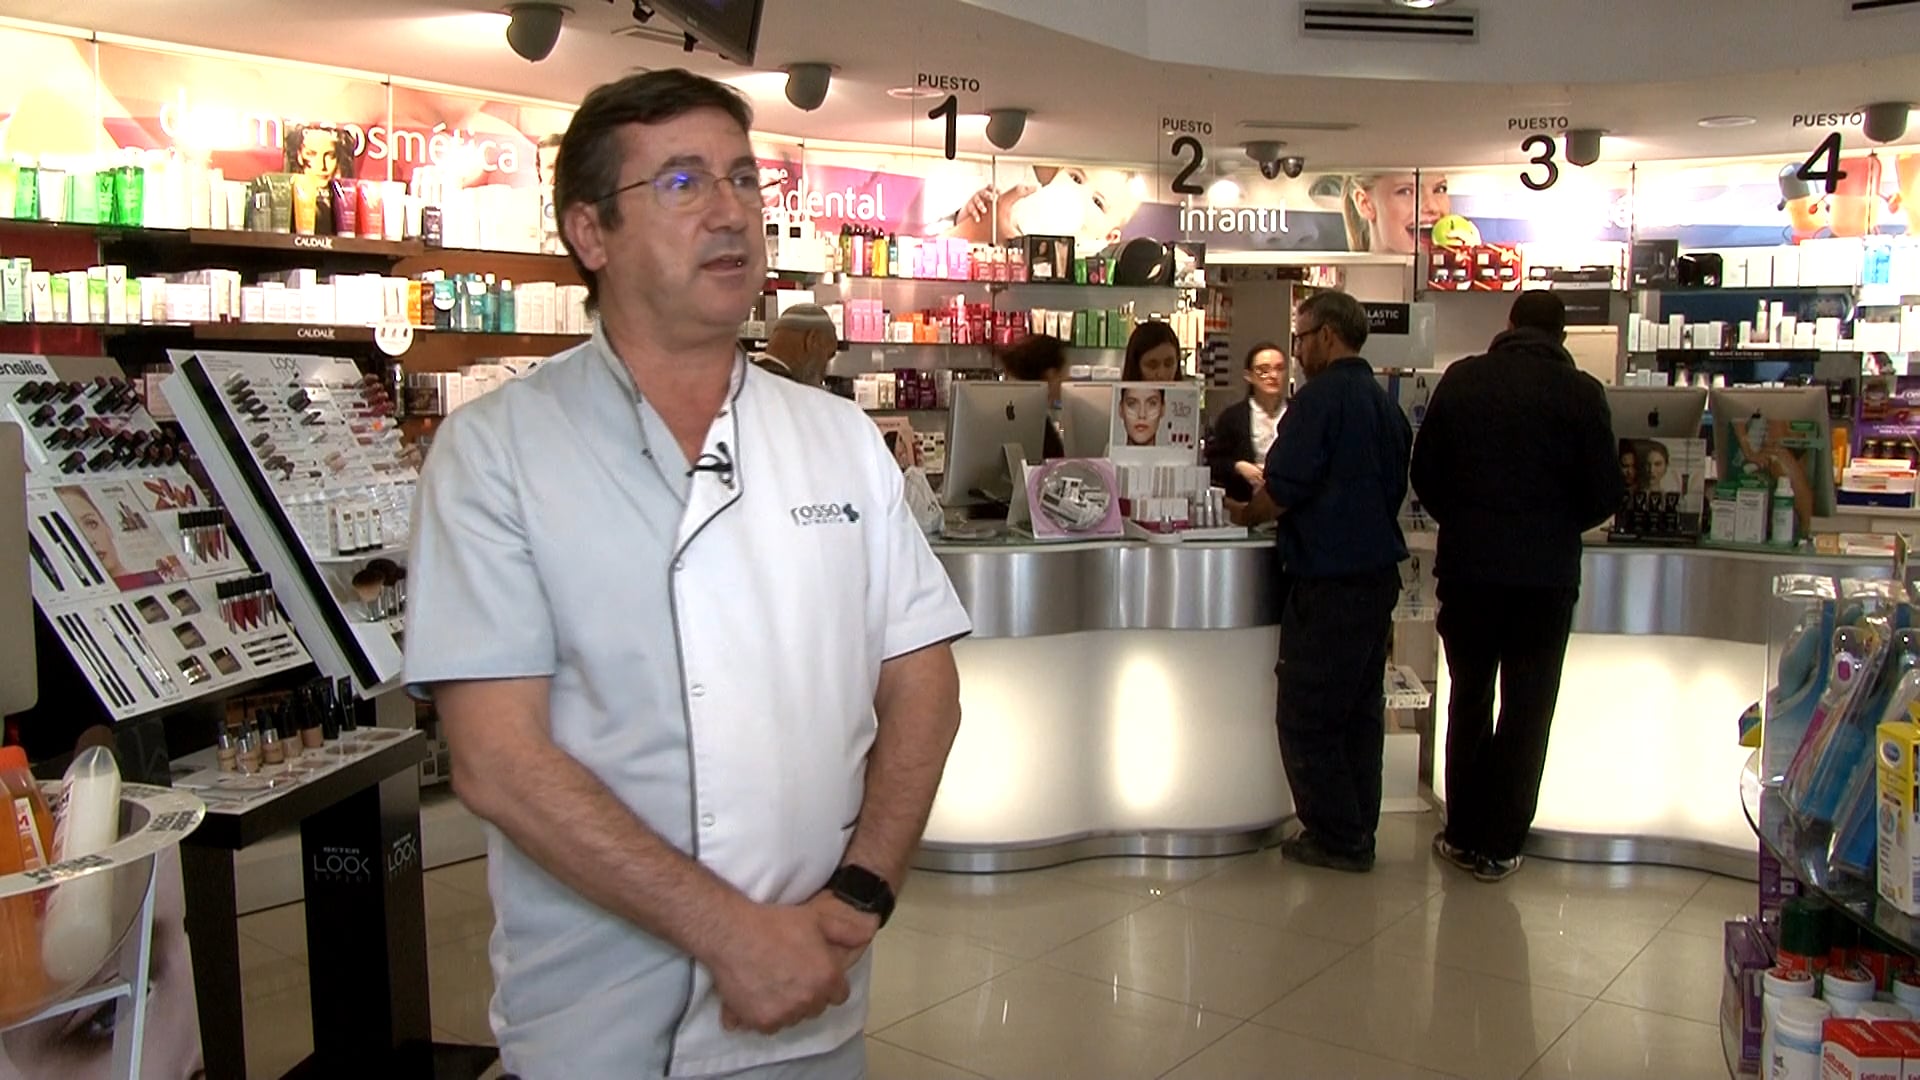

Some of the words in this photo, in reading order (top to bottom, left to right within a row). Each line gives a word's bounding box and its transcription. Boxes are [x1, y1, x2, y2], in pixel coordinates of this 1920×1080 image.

[917, 73, 980, 93] PUESTO
[928, 94, 958, 161] 1
[1162, 117, 1212, 135] PUESTO
[1508, 116, 1569, 131] PUESTO
[1792, 111, 1863, 128] PUESTO
[1171, 135, 1204, 195] 2
[1519, 134, 1559, 191] 3
[1797, 131, 1847, 194] 4
[1179, 200, 1289, 233] infantil
[1368, 309, 1399, 319] LASTIC
[313, 854, 370, 874] LOOK
